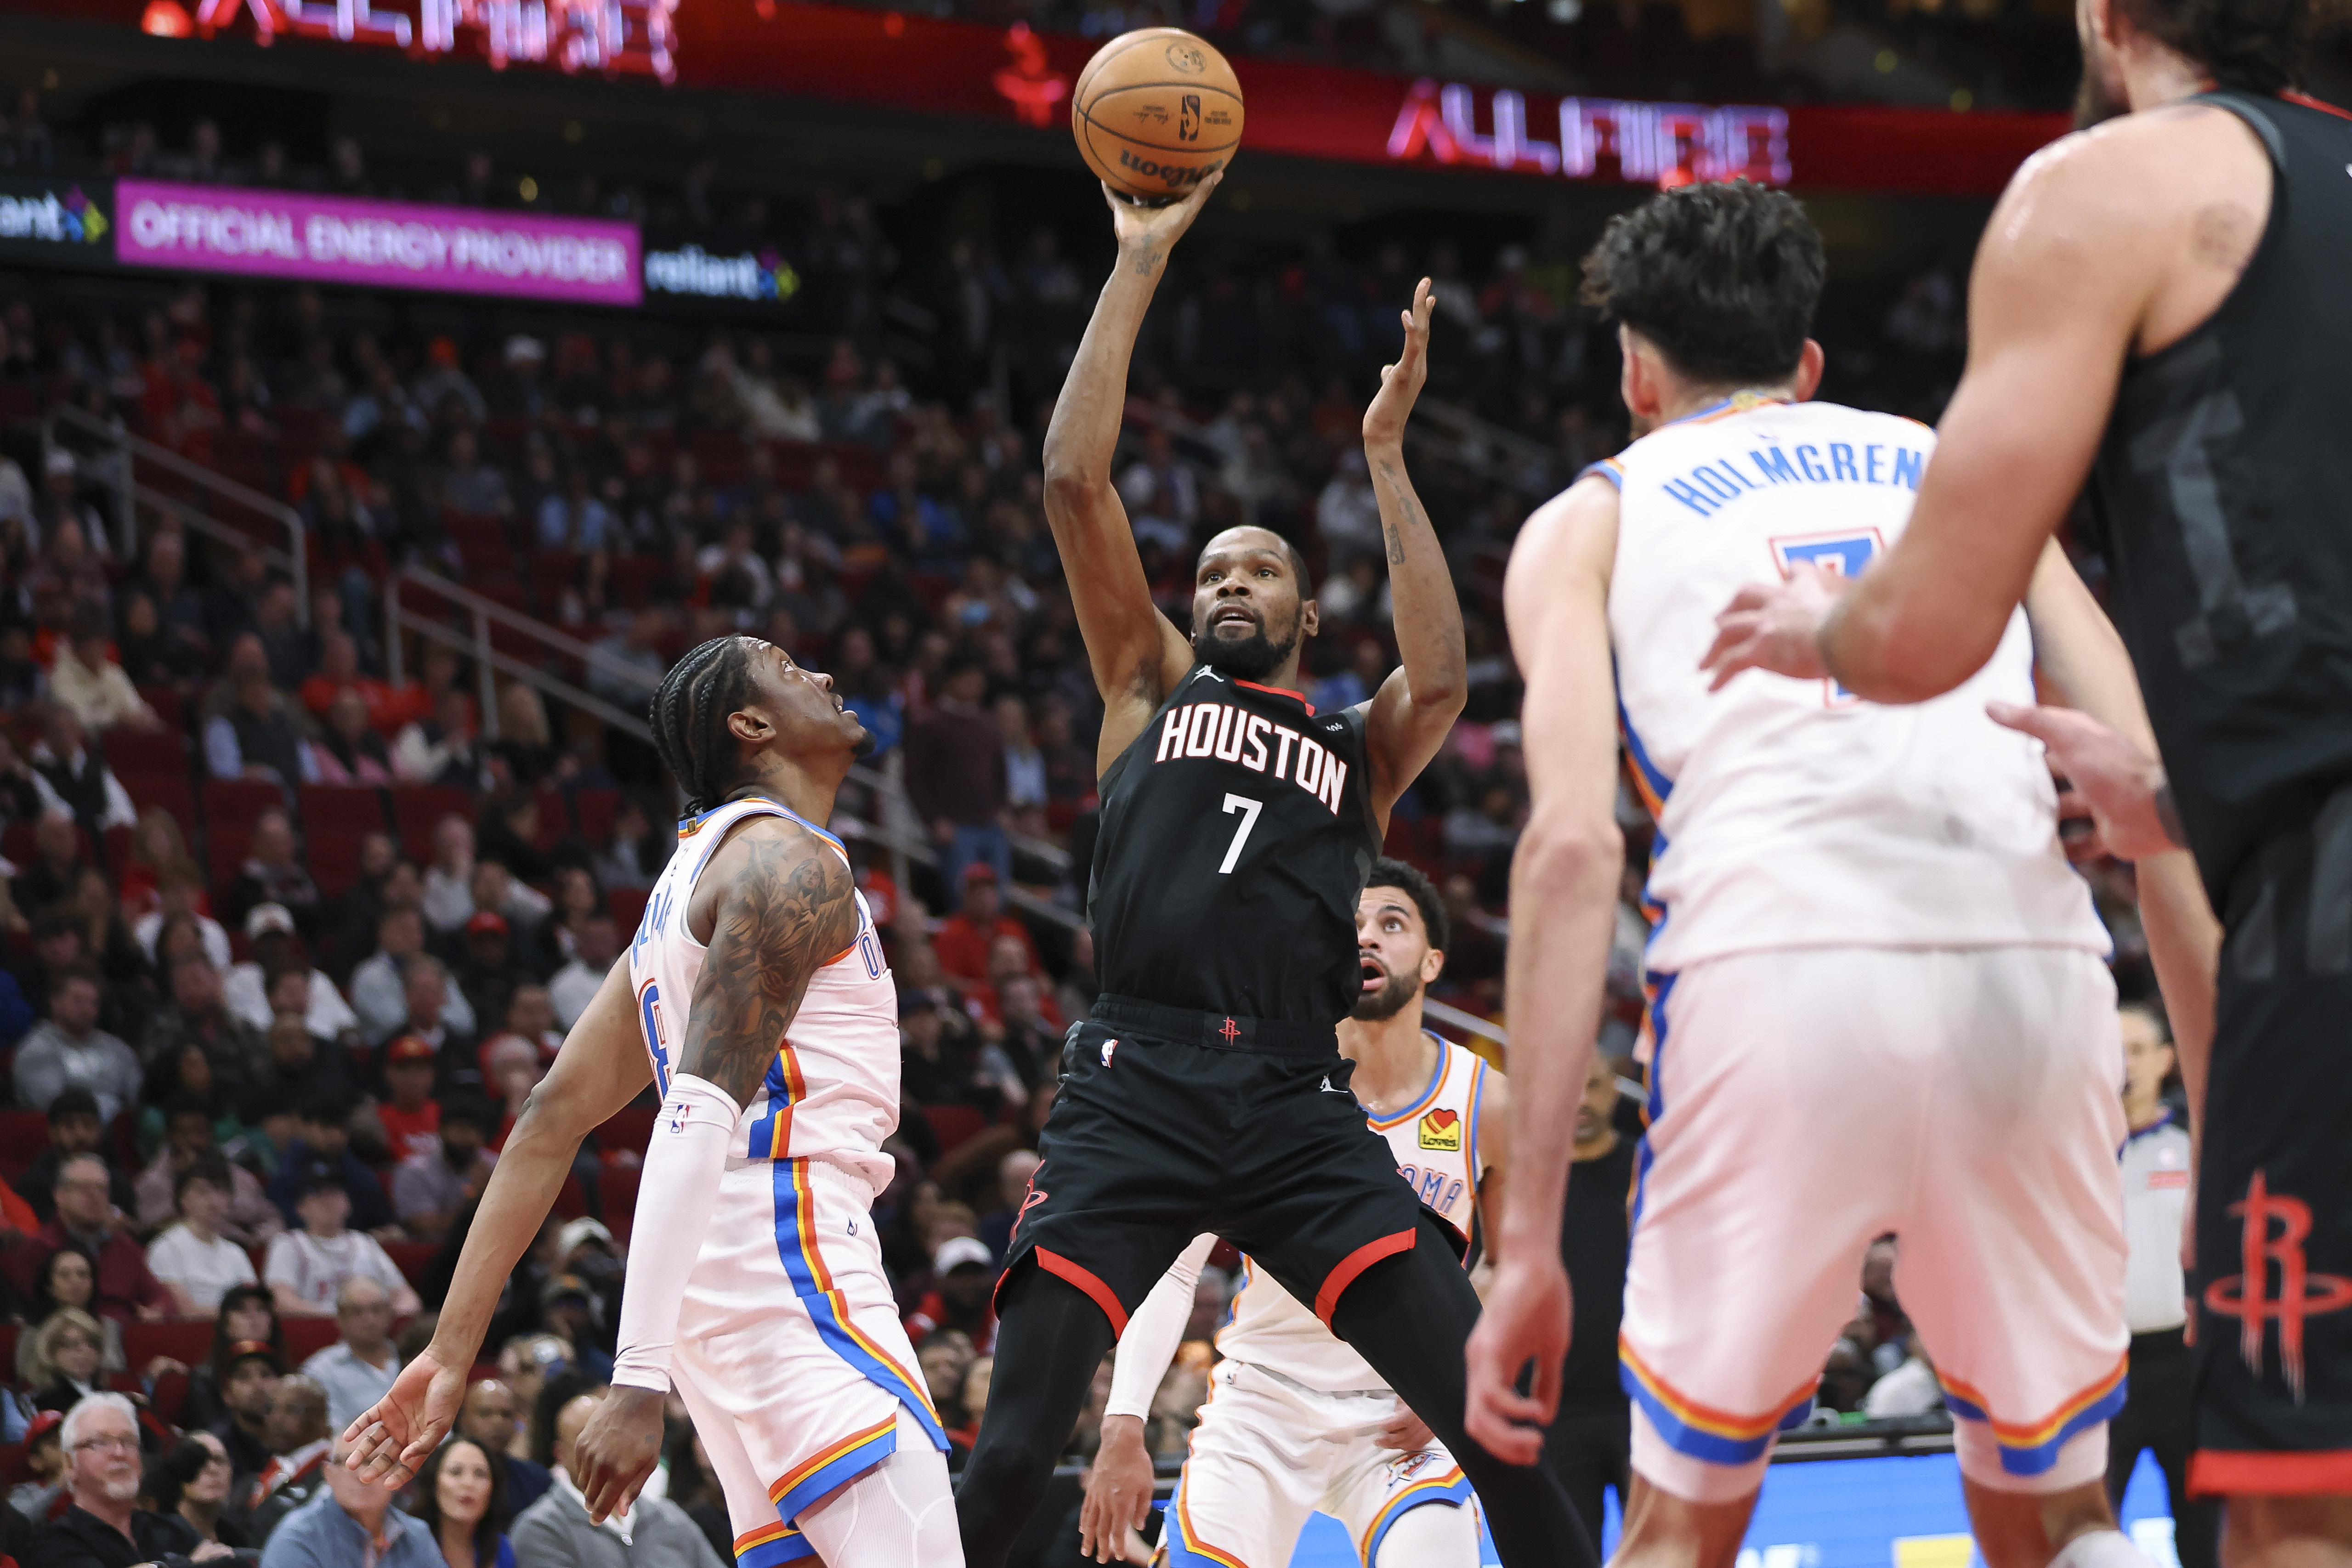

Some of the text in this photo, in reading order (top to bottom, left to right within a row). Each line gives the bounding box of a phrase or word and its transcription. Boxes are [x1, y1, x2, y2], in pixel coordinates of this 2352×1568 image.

[130, 199, 628, 287] OFFICIAL ENERGY PROVIDER
[645, 243, 763, 301] reliant
[1662, 442, 1922, 518] HOLMGREN
[1154, 702, 1349, 816] HOUSTON
[1218, 792, 1264, 874] 7
